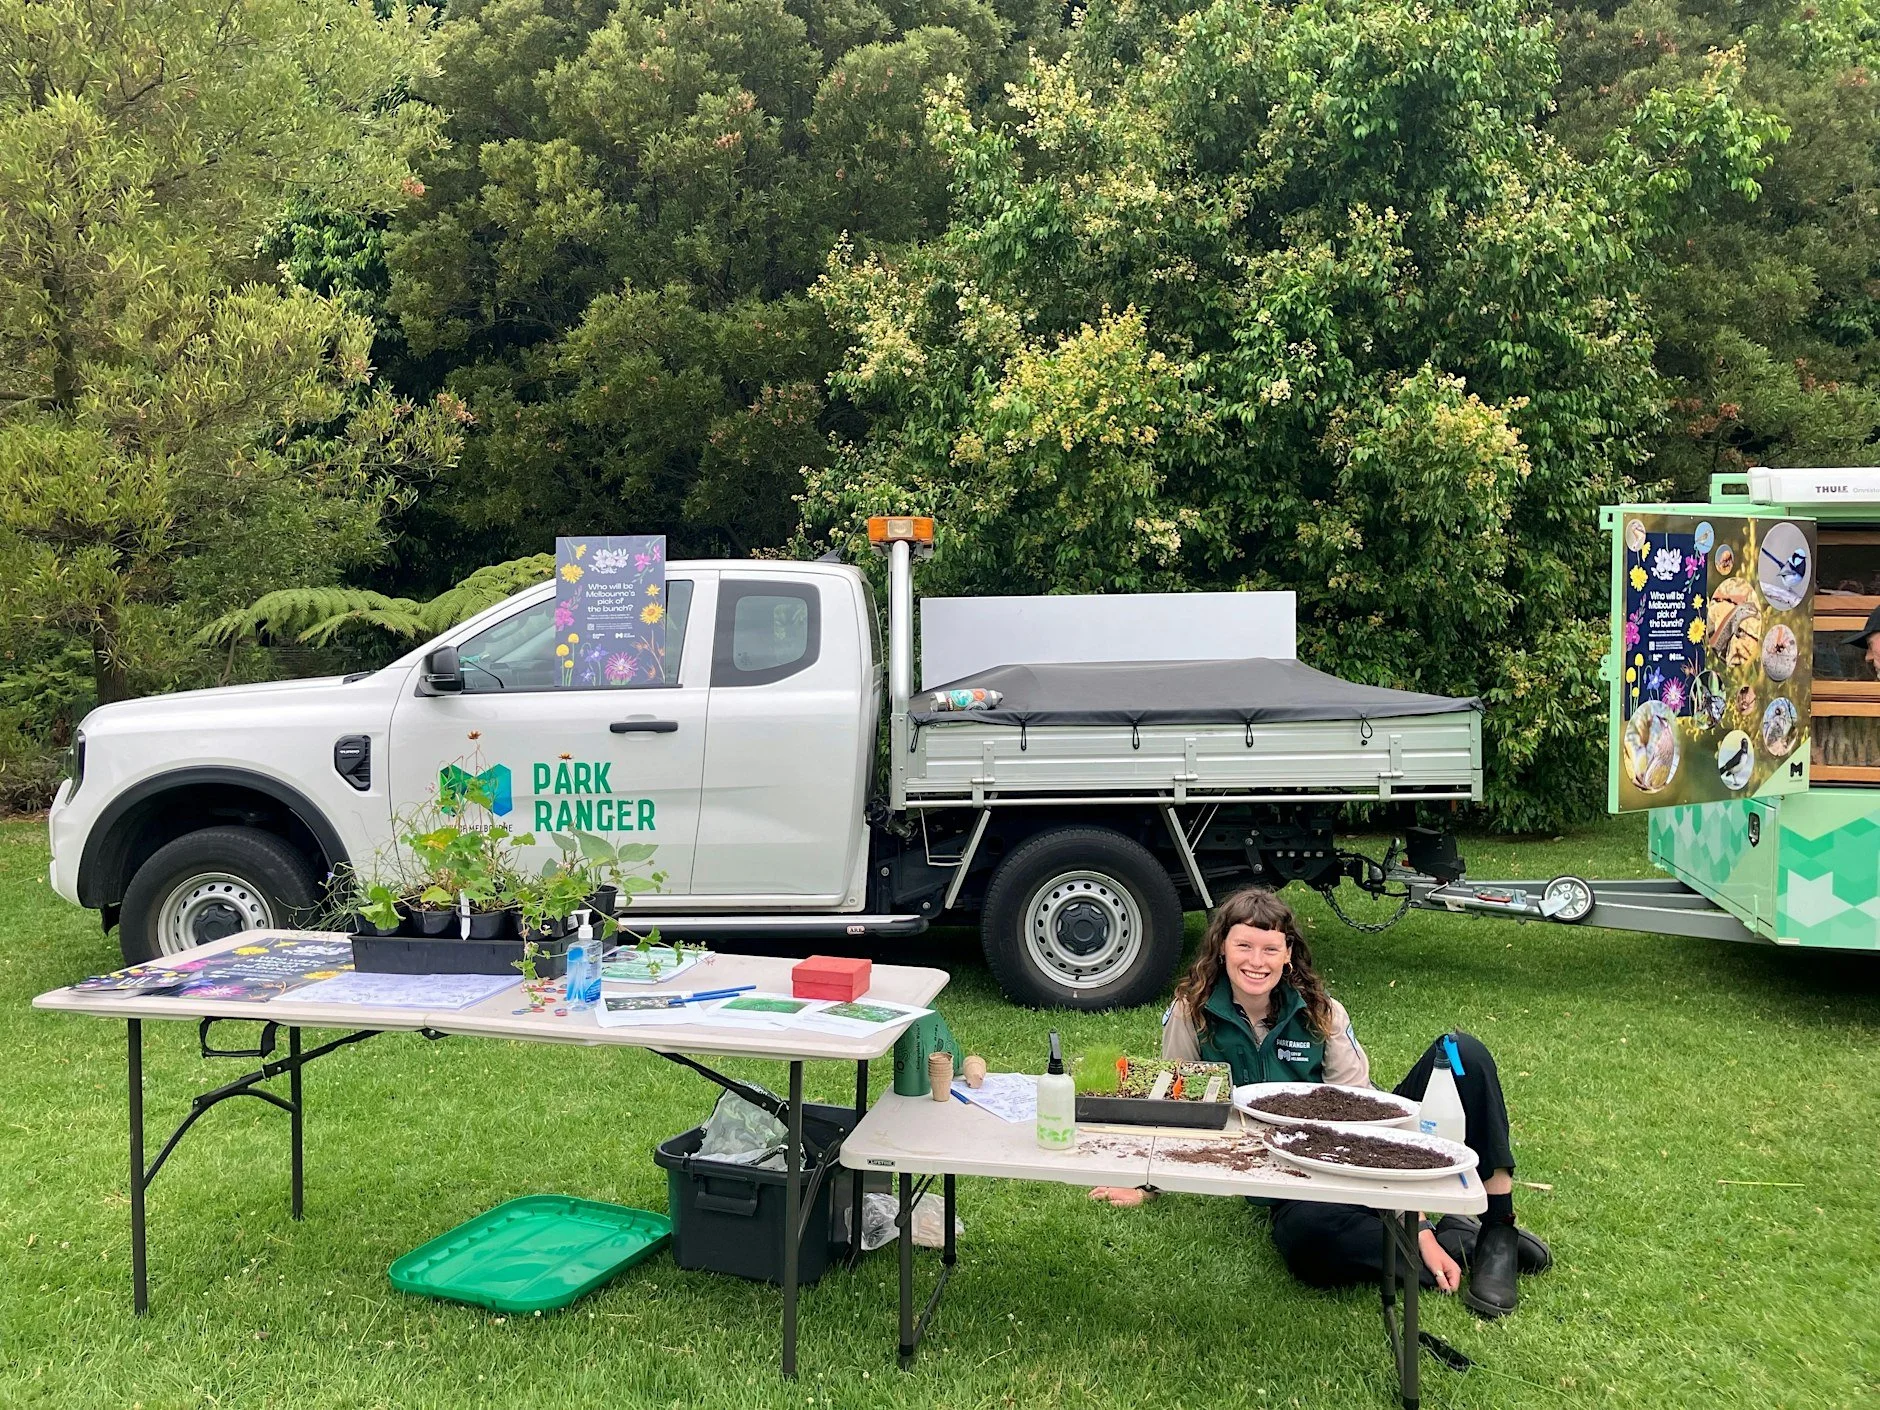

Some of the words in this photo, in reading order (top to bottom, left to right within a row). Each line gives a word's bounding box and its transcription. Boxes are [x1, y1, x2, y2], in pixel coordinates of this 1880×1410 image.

[585, 590, 636, 598] Melbourne's
[1650, 591, 1666, 600] Who
[1666, 591, 1676, 600] will
[1676, 591, 1685, 600] be
[597, 598, 614, 606] pick
[1648, 600, 1686, 609] Melbourne's
[603, 604, 634, 612] bunch?
[1656, 610, 1670, 620] pick
[1670, 609, 1678, 618] of
[1649, 619, 1661, 628] the
[1660, 618, 1684, 628] bunch?
[533, 762, 613, 795] PARK
[534, 798, 656, 832] RANGER
